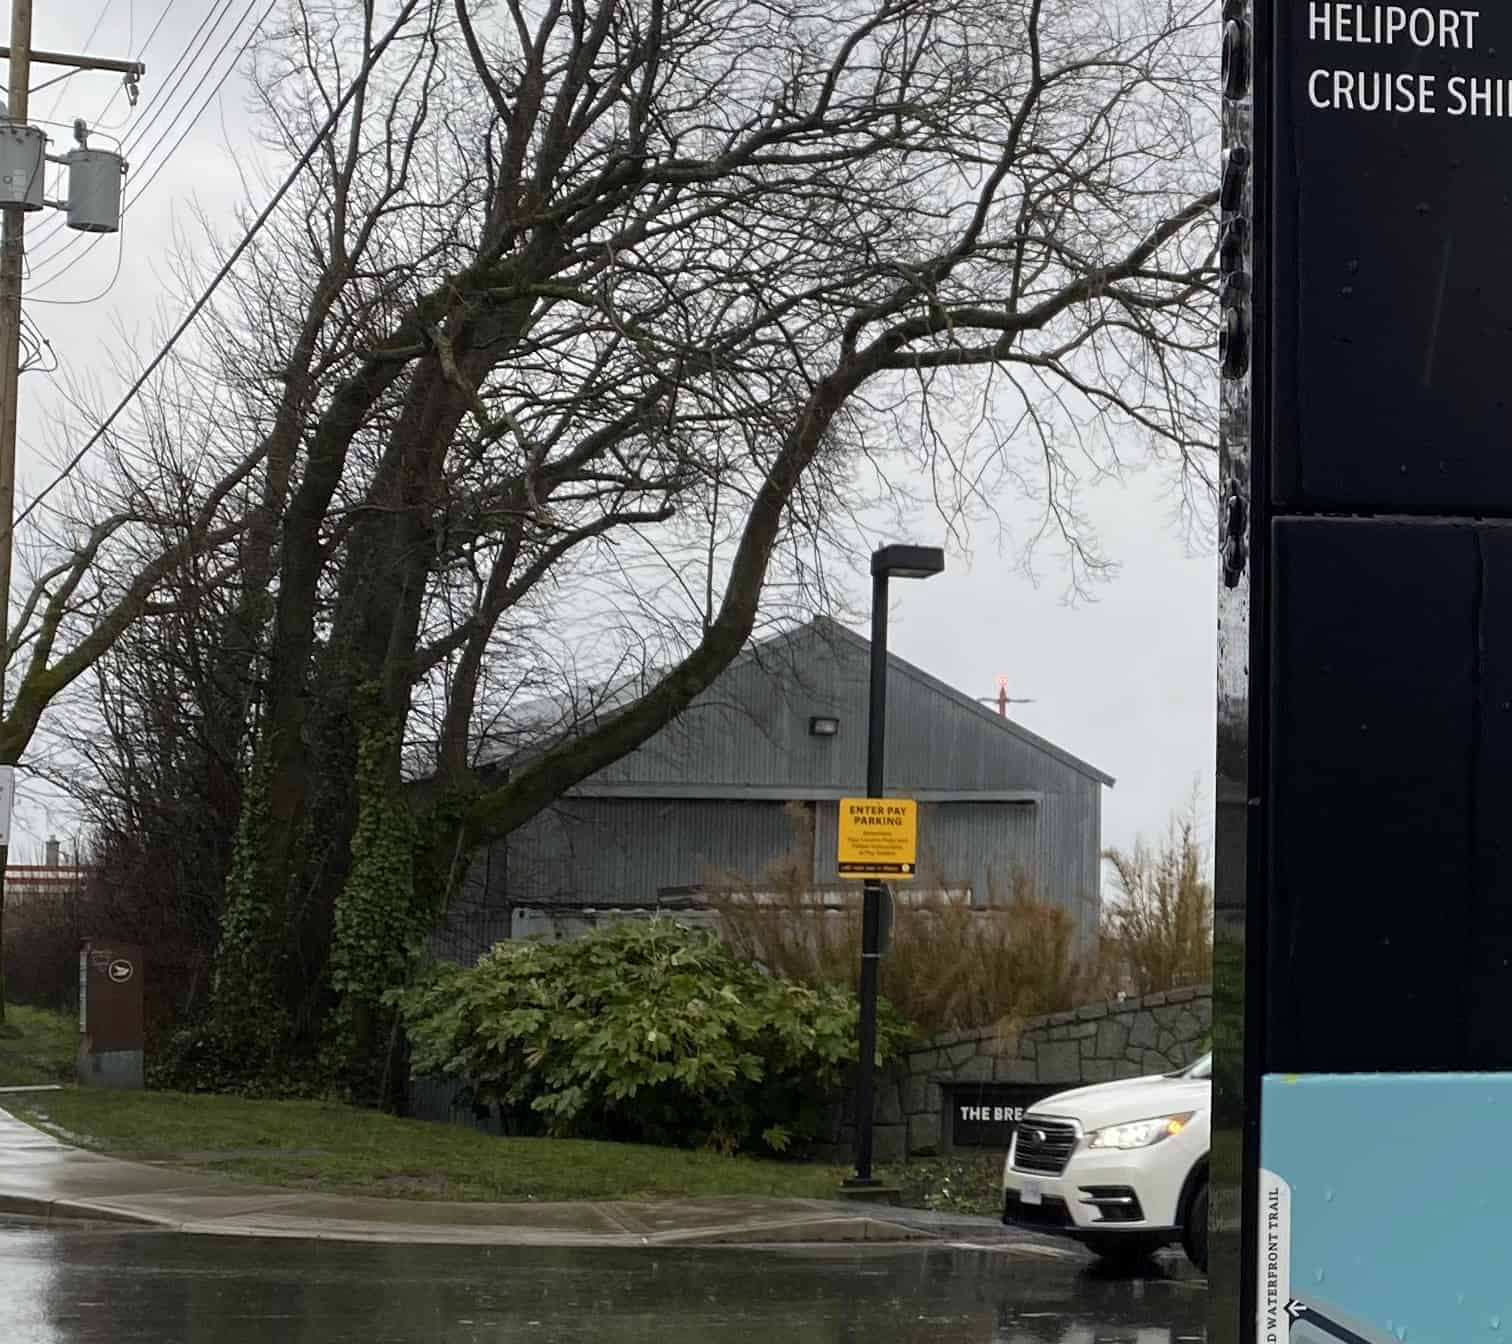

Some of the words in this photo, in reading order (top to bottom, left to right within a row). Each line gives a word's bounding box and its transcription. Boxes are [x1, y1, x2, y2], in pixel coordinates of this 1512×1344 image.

[1308, 2, 1479, 49] HELIPORT
[1308, 69, 1436, 114] CRUISE
[850, 806, 884, 815] ENTER
[887, 806, 906, 816] PAY
[854, 816, 902, 825] PARKING
[960, 1106, 990, 1121] THE
[1269, 1187, 1279, 1229] TRAIL
[1267, 1233, 1278, 1330] WATERFRONT
